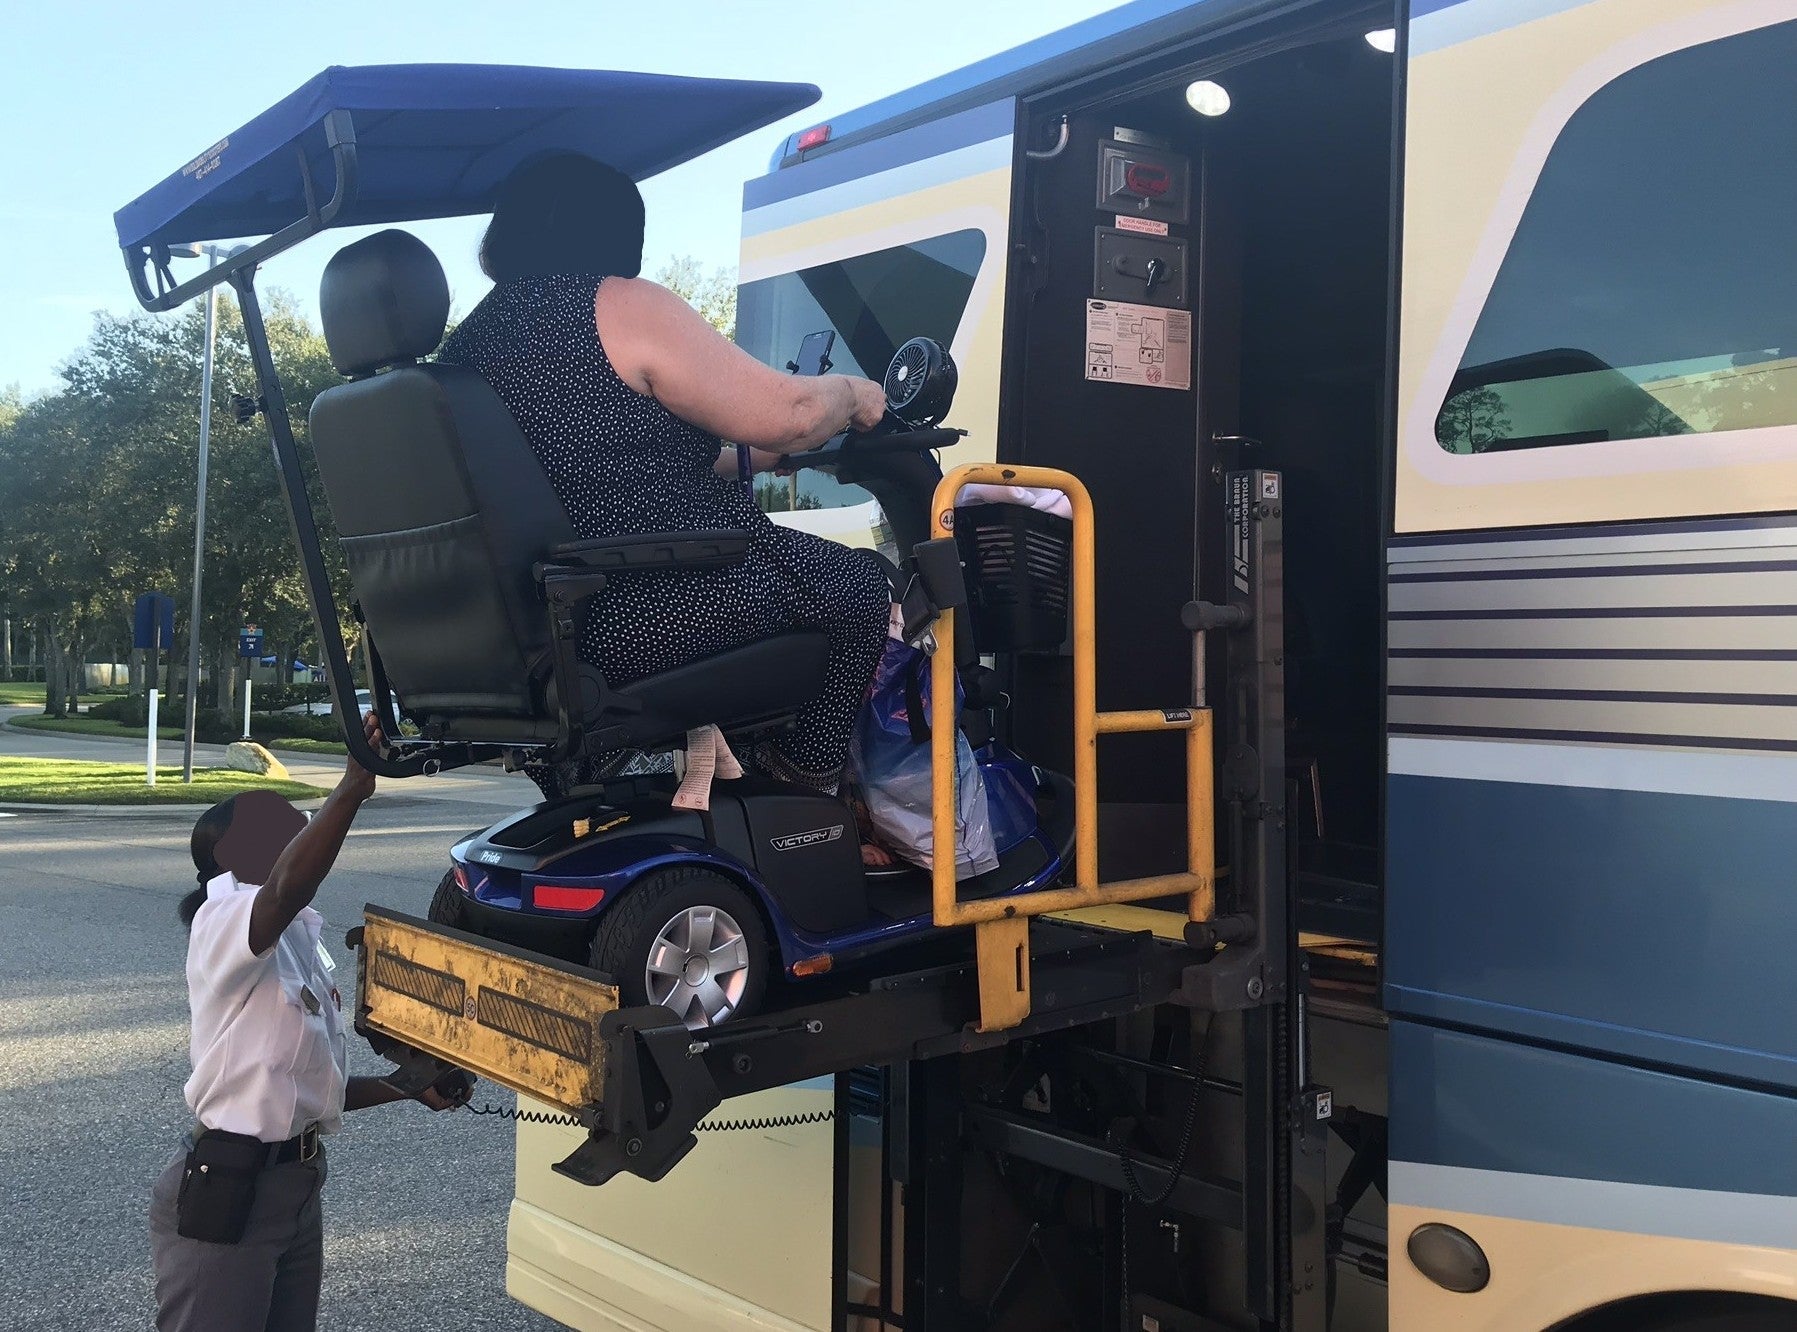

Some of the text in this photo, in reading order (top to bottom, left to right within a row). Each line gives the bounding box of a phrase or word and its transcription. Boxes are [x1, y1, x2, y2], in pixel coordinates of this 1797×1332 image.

[1241, 477, 1249, 538] CORPORATION
[776, 831, 827, 848] VICTORY
[480, 850, 501, 864] Pride
